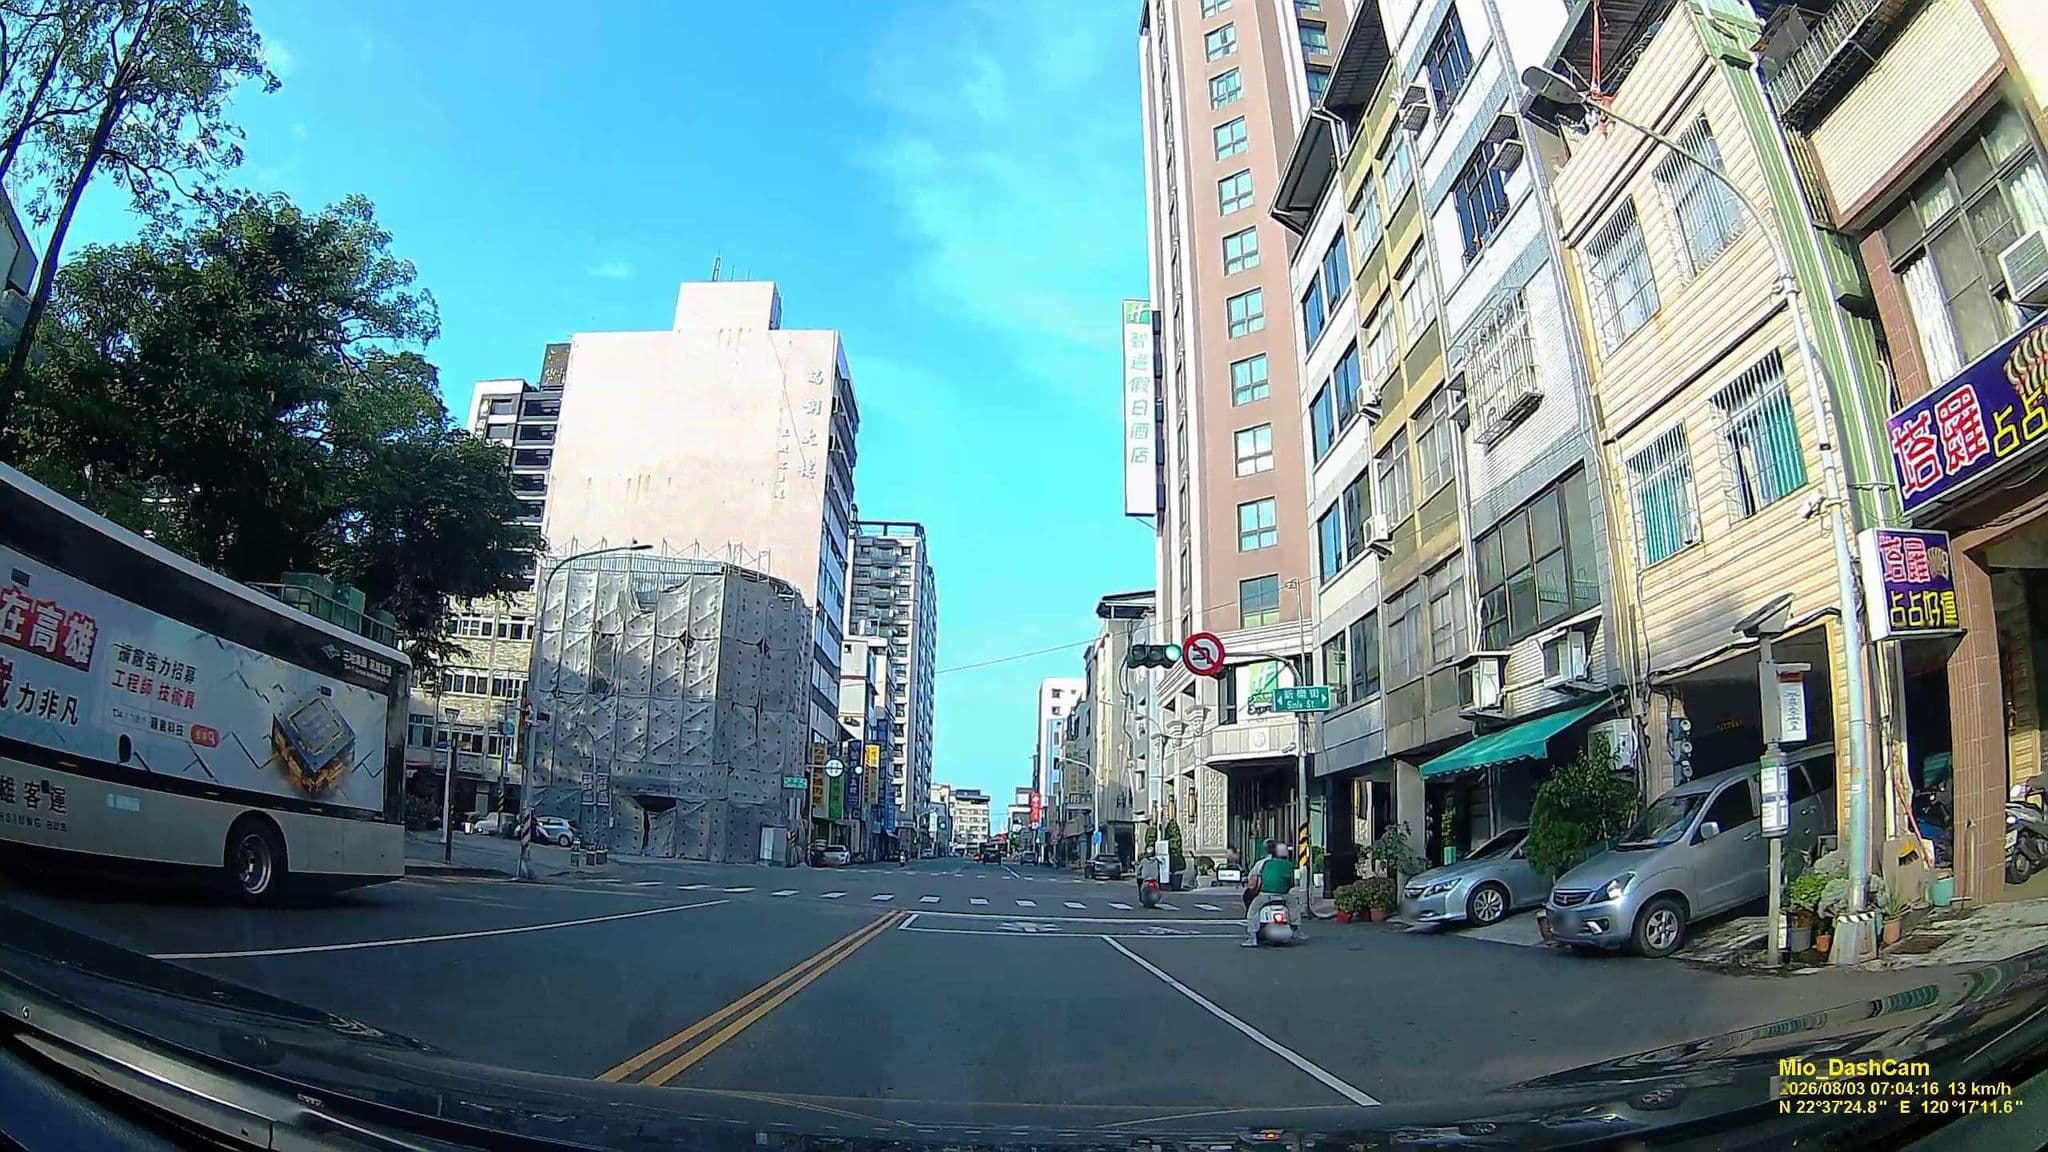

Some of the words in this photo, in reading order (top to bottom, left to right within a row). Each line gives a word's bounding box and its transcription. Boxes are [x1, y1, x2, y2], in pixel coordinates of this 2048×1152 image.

[1892, 383, 1991, 499] 塔羅
[1992, 376, 2048, 458] 占占
[1879, 536, 1931, 582] 塔羅
[0, 590, 95, 664] 在高雄
[1890, 590, 1959, 626] 占占好運
[112, 669, 153, 696] 工程師
